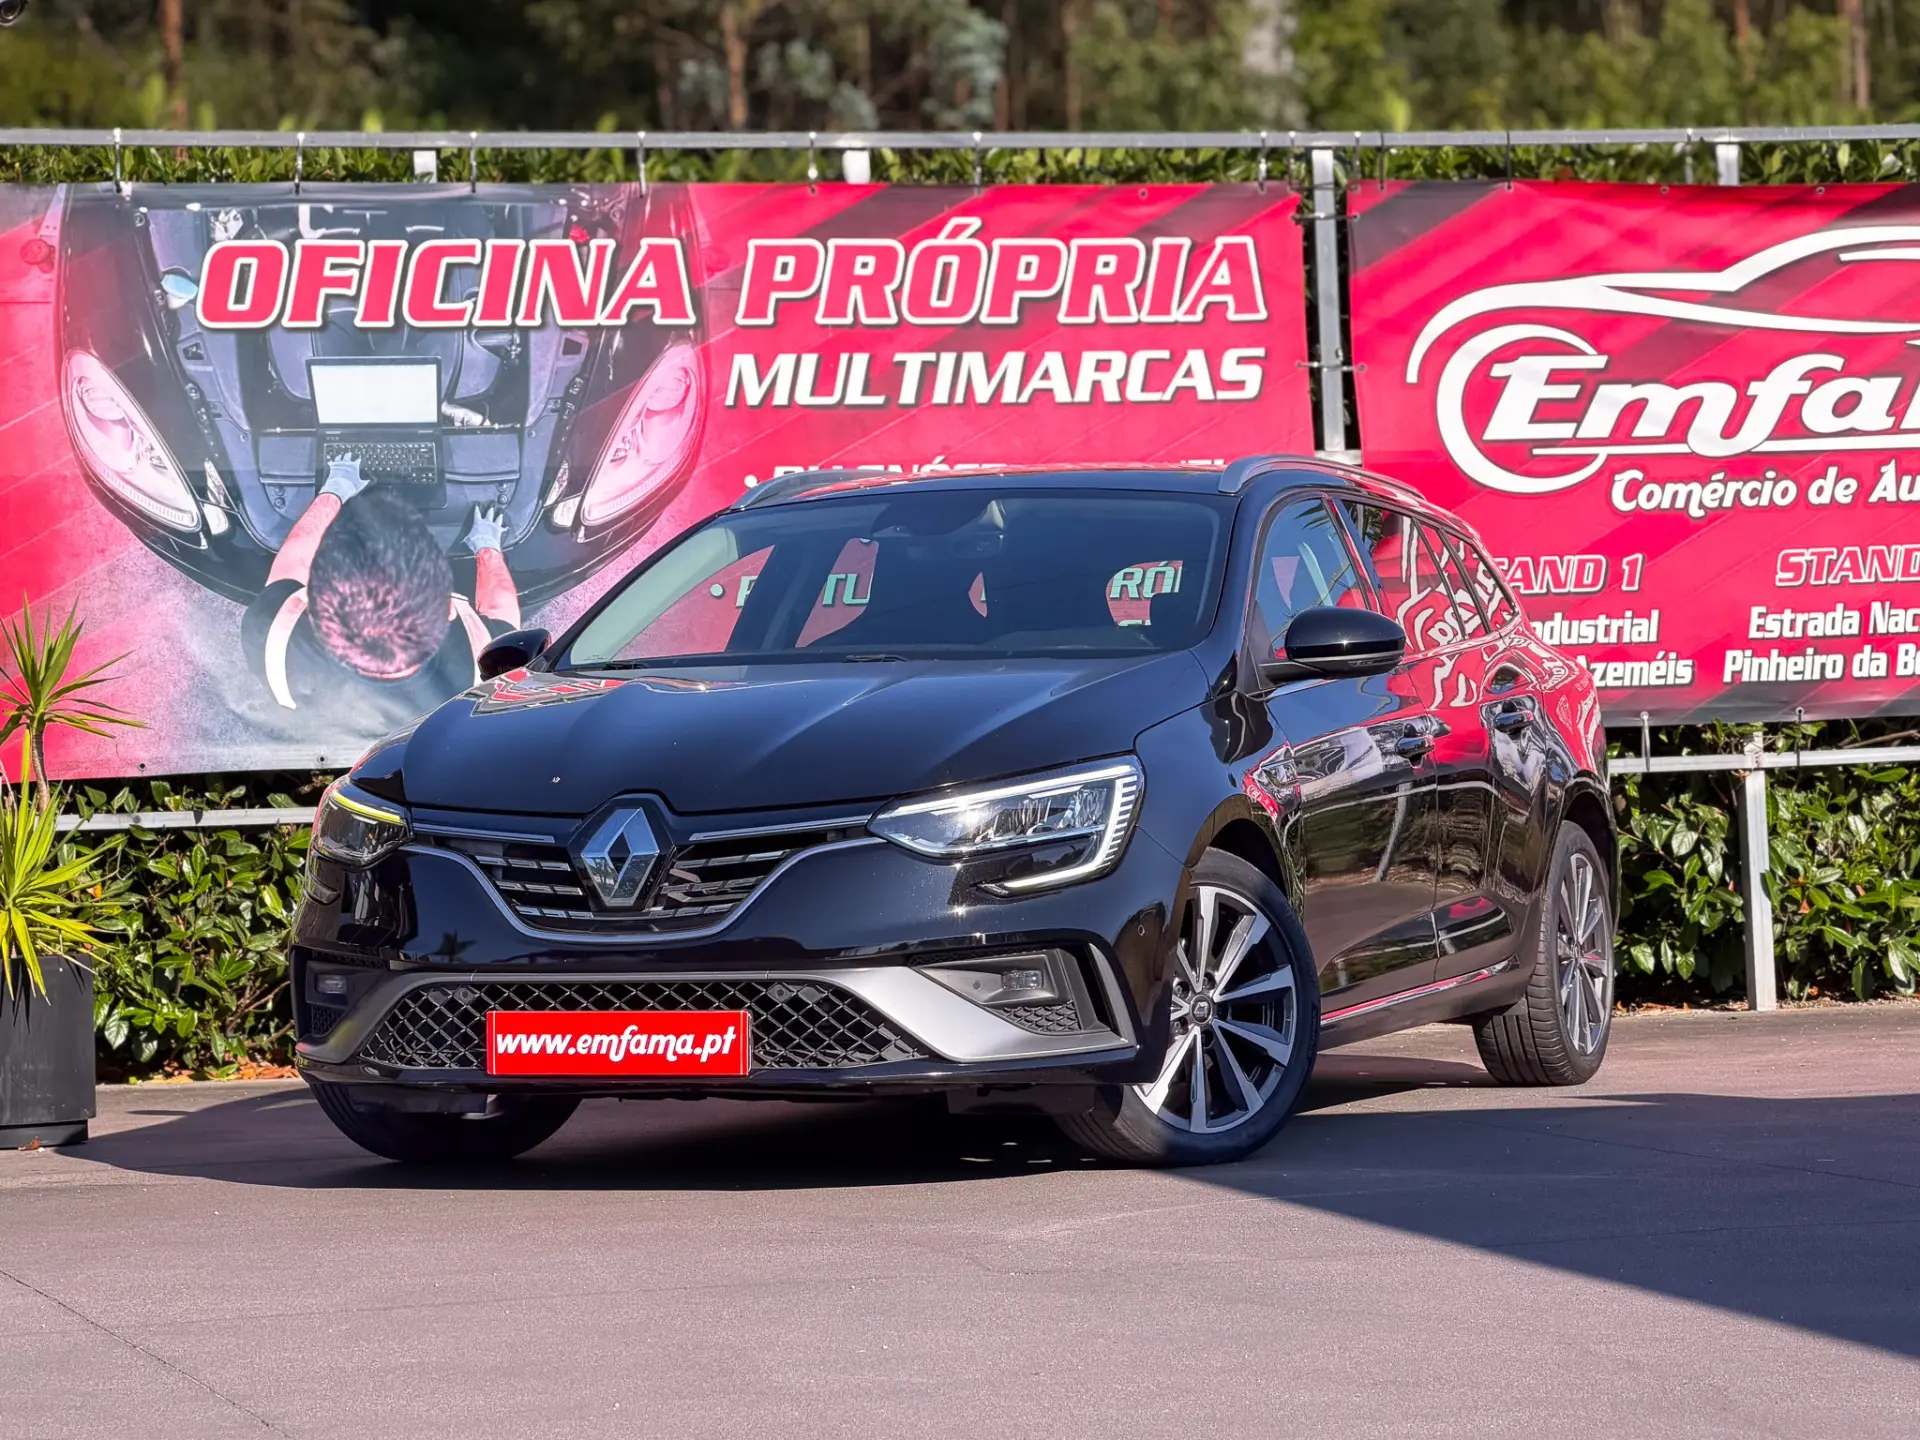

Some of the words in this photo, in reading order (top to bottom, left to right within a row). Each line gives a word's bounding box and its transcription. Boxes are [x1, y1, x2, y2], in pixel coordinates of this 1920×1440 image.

[196, 238, 697, 329] OFICINA
[734, 217, 1268, 325] PRÓPRIA
[724, 347, 1267, 407] MULTIMARCAS
[1481, 353, 1920, 458] Emfa
[1611, 470, 1798, 518] Comércio
[1808, 466, 1853, 504] de
[1493, 554, 1607, 594] AND
[1621, 553, 1643, 592] 1
[1748, 602, 1861, 639] Estrada
[1722, 647, 1845, 683] Pinheiro
[1852, 644, 1888, 679] da
[496, 1024, 737, 1063] www.emfama.pt
